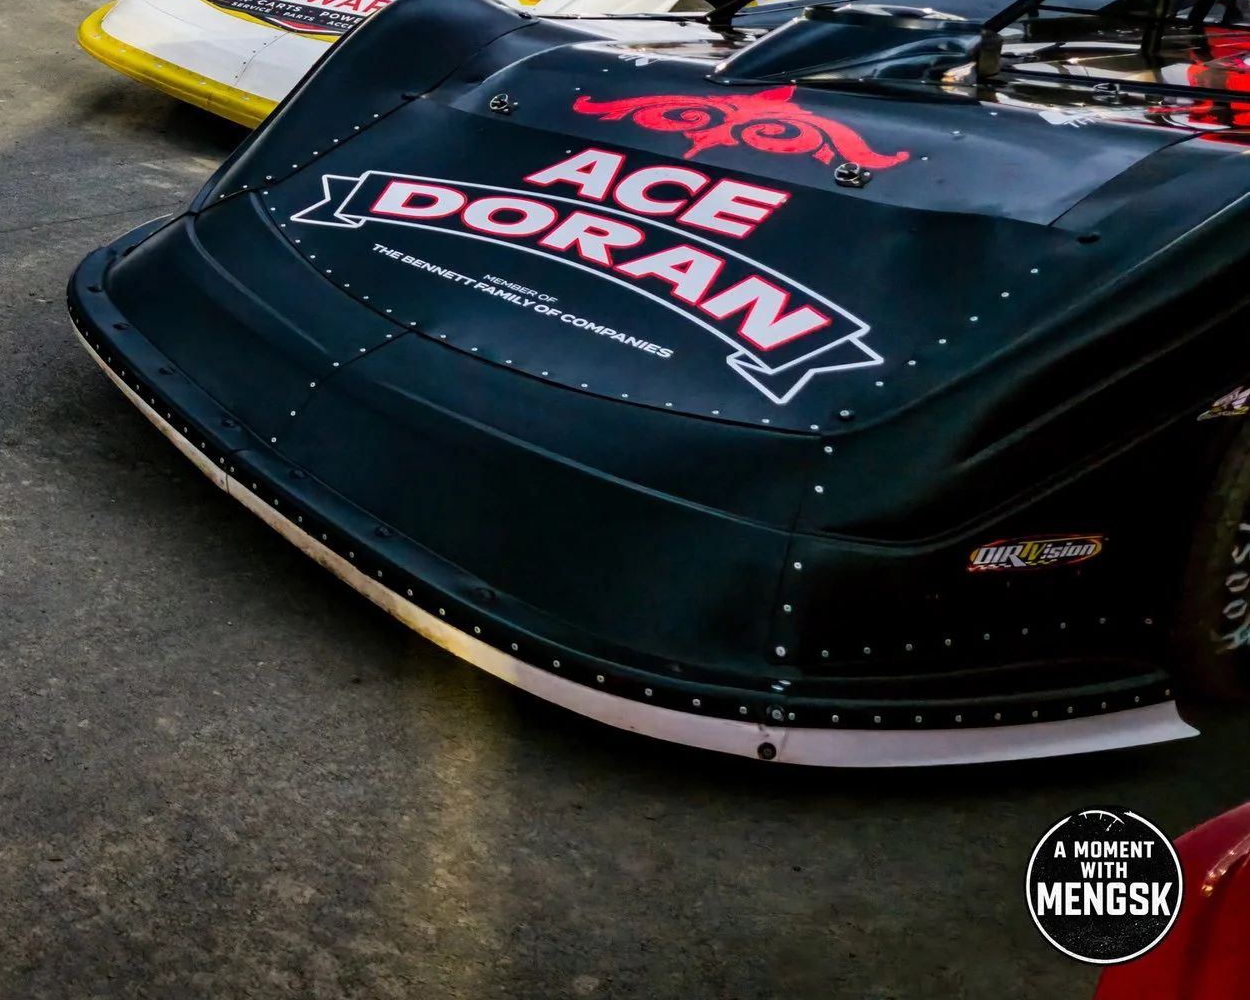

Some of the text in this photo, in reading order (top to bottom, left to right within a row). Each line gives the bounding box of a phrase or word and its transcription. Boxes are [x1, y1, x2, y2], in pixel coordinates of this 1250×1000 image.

[231, 1, 272, 14] SERVICE
[282, 11, 316, 23] PARTS
[257, 0, 303, 13] CARTS
[523, 147, 791, 239] ACE
[369, 180, 834, 351] DORAN
[372, 243, 675, 359] THE BENNETT FAMILY OF COMPANIES
[483, 274, 559, 303] MEMBER OF
[972, 541, 1098, 567] DIRTVision
